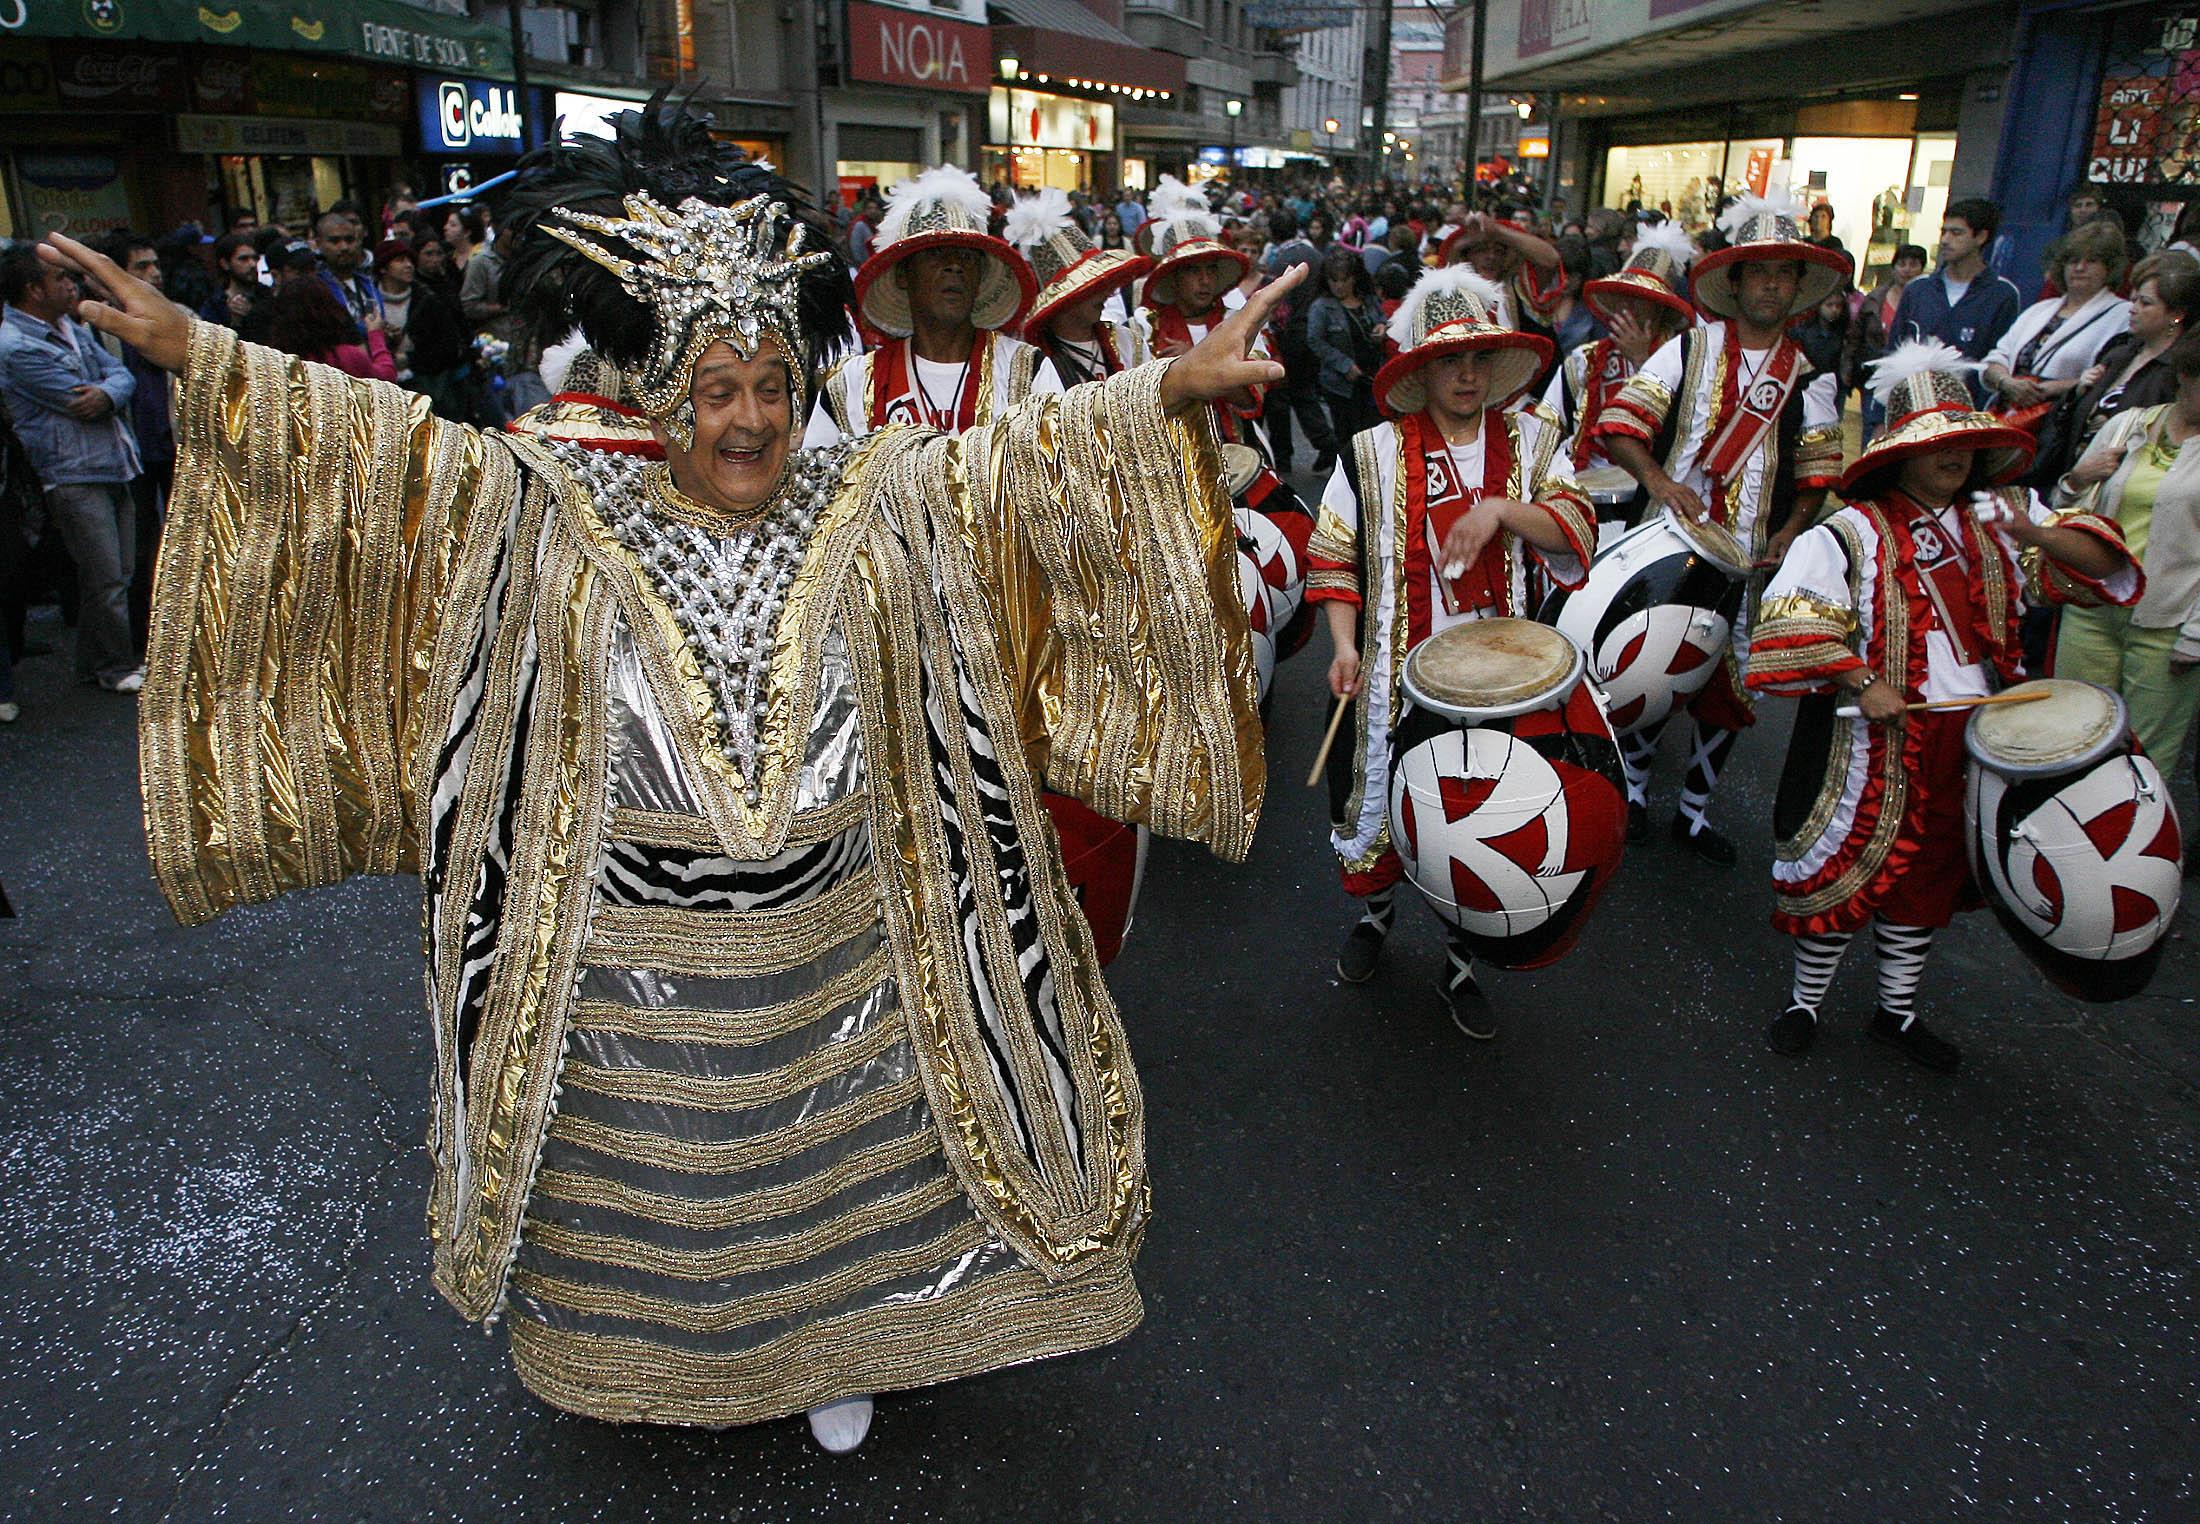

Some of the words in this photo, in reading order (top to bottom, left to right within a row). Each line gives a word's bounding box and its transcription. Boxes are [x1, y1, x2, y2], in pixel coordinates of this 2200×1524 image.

[363, 22, 411, 60] FUENTE
[413, 33, 432, 63] DE
[434, 37, 470, 67] SODA
[879, 20, 969, 84] NOIA
